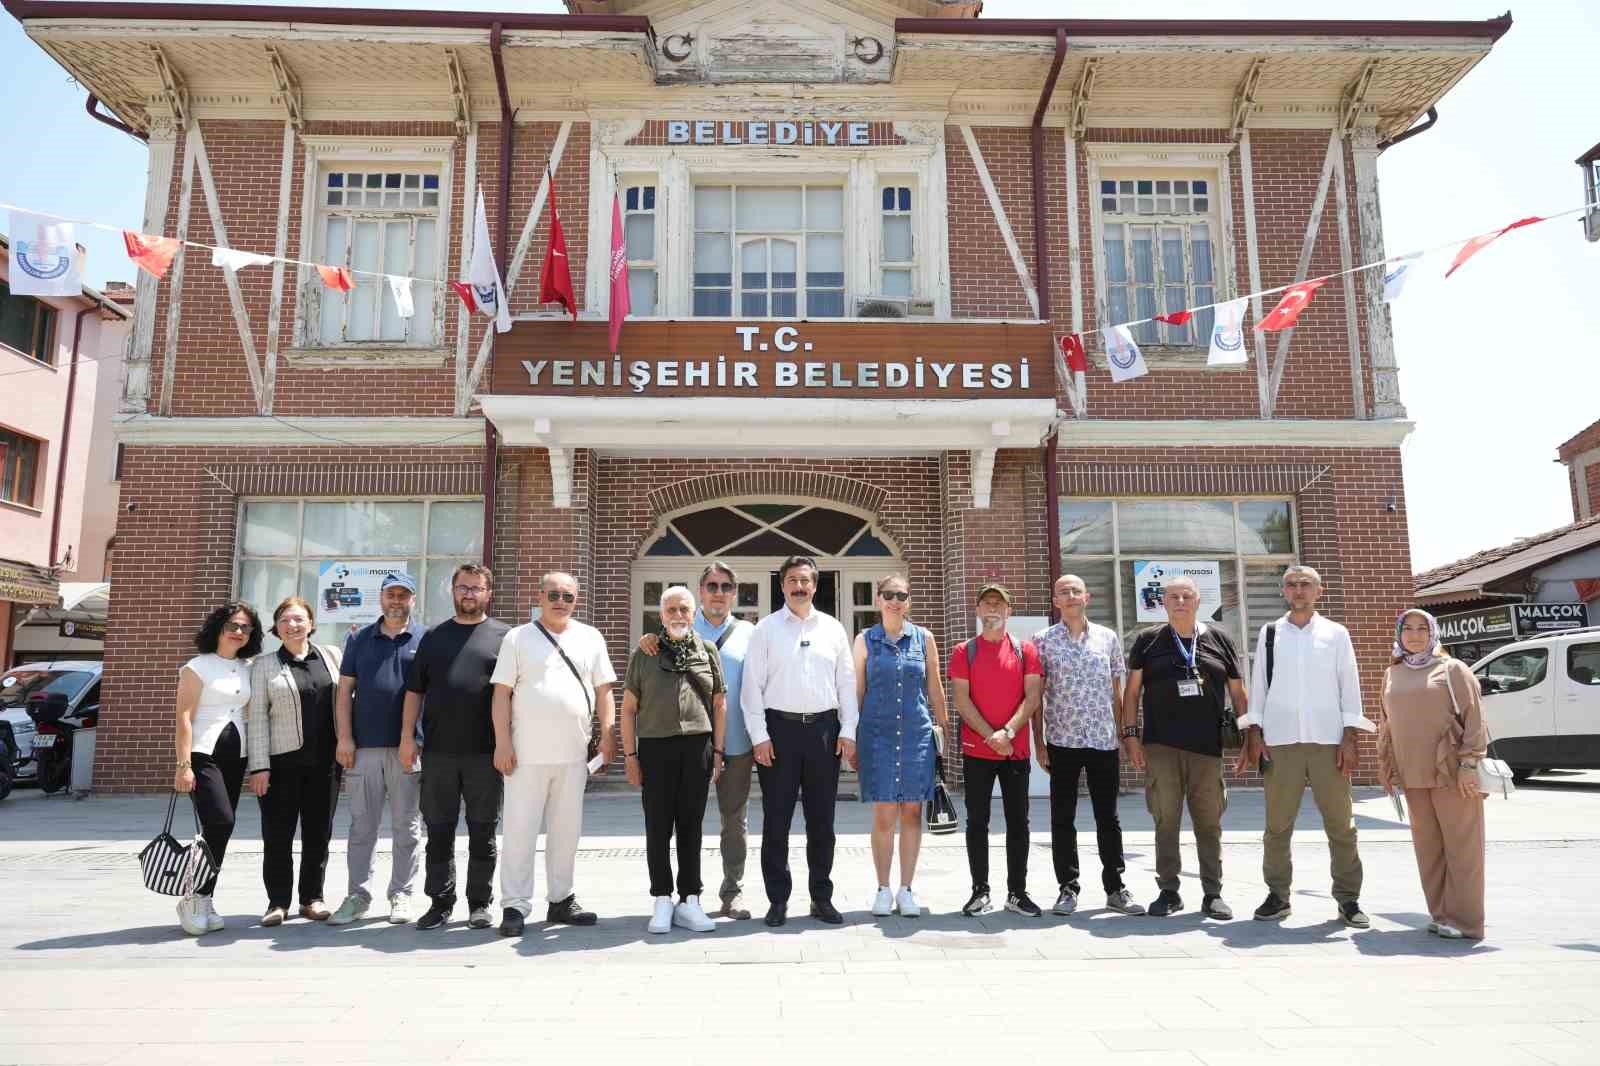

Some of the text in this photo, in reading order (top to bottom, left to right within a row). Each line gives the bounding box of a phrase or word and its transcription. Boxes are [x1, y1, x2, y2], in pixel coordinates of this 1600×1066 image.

[736, 326, 813, 351] T.C.
[521, 352, 1030, 392] YENİŞEHİR BELEDİYESİ
[1518, 606, 1583, 620] MALÇOK
[1438, 616, 1487, 640] MALÇOK
